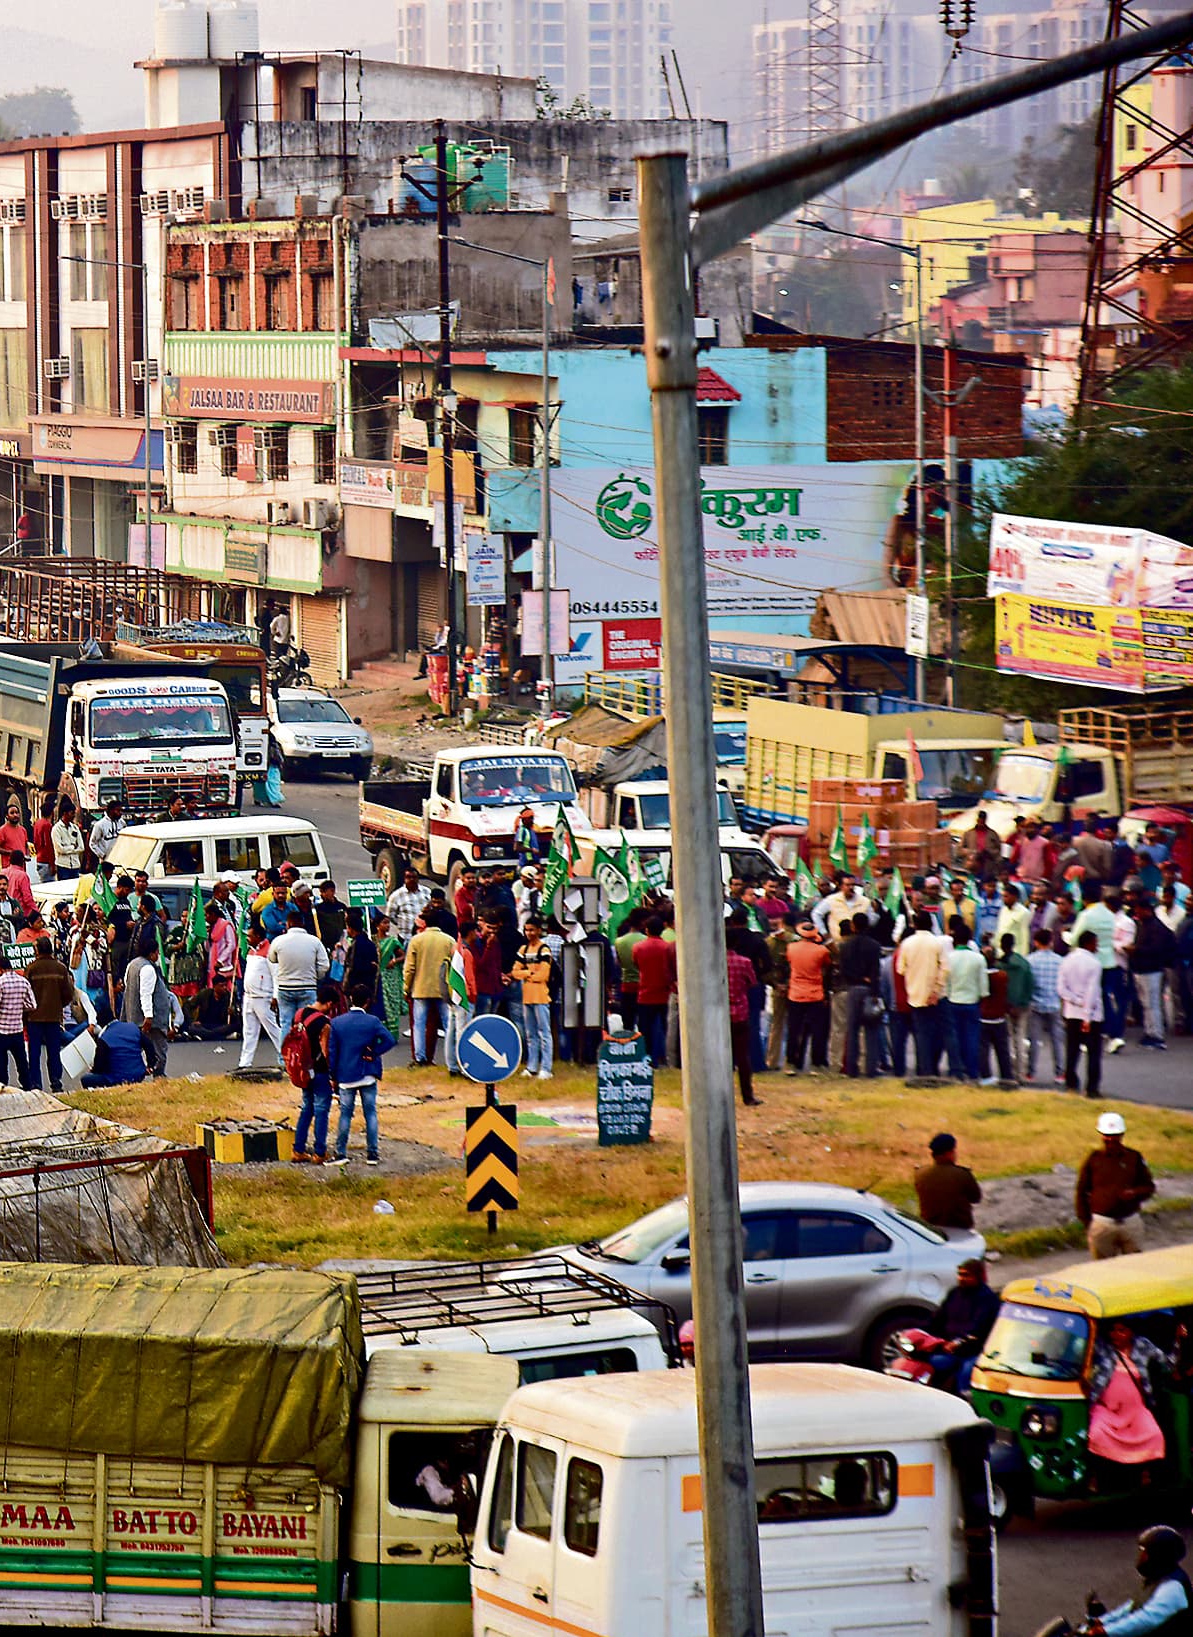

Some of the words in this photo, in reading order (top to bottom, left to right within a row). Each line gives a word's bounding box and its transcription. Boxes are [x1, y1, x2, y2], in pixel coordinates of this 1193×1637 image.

[190, 388, 223, 409] JALSAA
[226, 391, 245, 410] BAR
[247, 391, 255, 411] &
[257, 391, 320, 414] RESTAURANT
[238, 443, 255, 464] BAR
[701, 480, 803, 528] कुरम
[475, 547, 495, 555] JAIN
[608, 630, 625, 640] THE
[609, 640, 652, 650] ORIGINAL
[609, 650, 642, 661] ENGINE
[108, 686, 148, 695] GOODS
[169, 685, 207, 694] CARRIER
[474, 758, 497, 768] JAI
[501, 757, 535, 766] MATA
[539, 757, 552, 765] DI
[0, 1503, 76, 1530] MAA
[112, 1509, 198, 1536] BATTO
[223, 1512, 307, 1540] BAYANI
